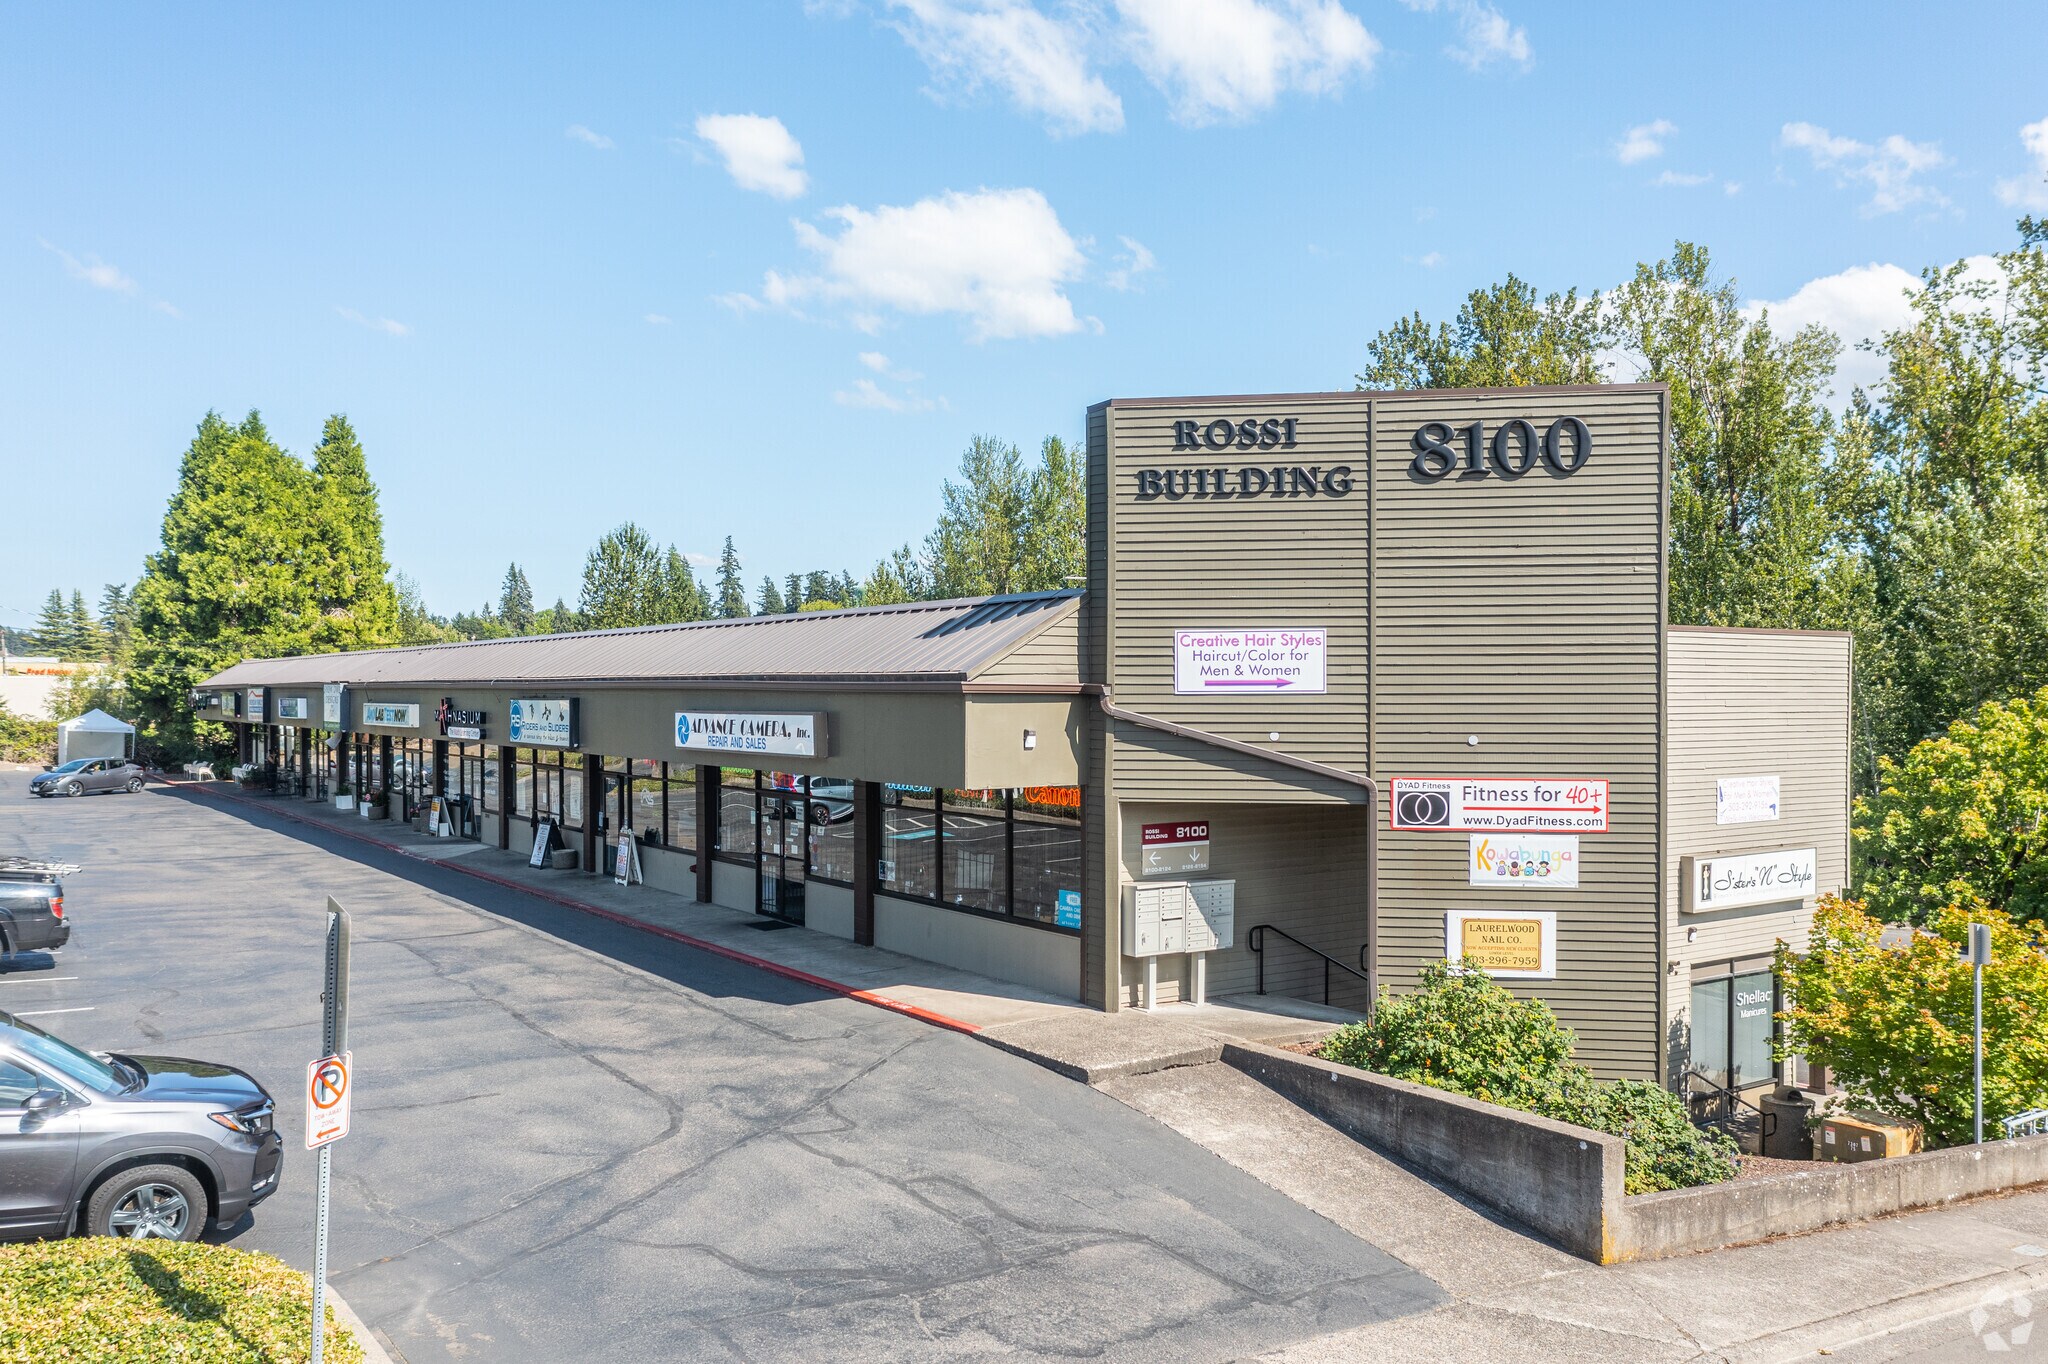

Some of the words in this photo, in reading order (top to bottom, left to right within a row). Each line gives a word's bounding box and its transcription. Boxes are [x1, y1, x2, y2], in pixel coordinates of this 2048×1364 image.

[1173, 417, 1300, 450] ROSSI
[1411, 415, 1593, 480] 8100
[1137, 465, 1356, 498] BUILDING
[1180, 634, 1240, 647] Creative
[1245, 634, 1276, 647] Hair
[1281, 633, 1322, 650] Styles
[1192, 649, 1285, 662] Haircut/Color
[1290, 649, 1309, 661] for
[1200, 665, 1230, 676] Men
[1234, 664, 1244, 676] &
[1248, 664, 1301, 676] Women
[691, 718, 736, 736] ADVANCE
[796, 727, 811, 739] Inc.
[707, 736, 729, 748] REPAIR
[730, 736, 743, 748] AND
[745, 737, 767, 749] SALES
[1397, 781, 1420, 789] DYAD
[1422, 782, 1451, 790] Fitness
[1025, 785, 1081, 807] Canon
[1463, 785, 1529, 802] Fitness
[1534, 785, 1562, 802] for
[1565, 785, 1603, 804] 40+
[1463, 815, 1603, 827] www.DyadFitness.com
[1176, 826, 1207, 838] 8100
[1476, 838, 1572, 871] Kowabunga
[1777, 863, 1813, 888] Style
[1469, 924, 1535, 933] LAURELWOOD
[1481, 935, 1504, 944] NAIL
[1506, 936, 1522, 944] CO.
[1465, 955, 1538, 966] 03-296-7959
[1736, 989, 1771, 1007] Shellac
[1740, 1007, 1767, 1019] Manicures
